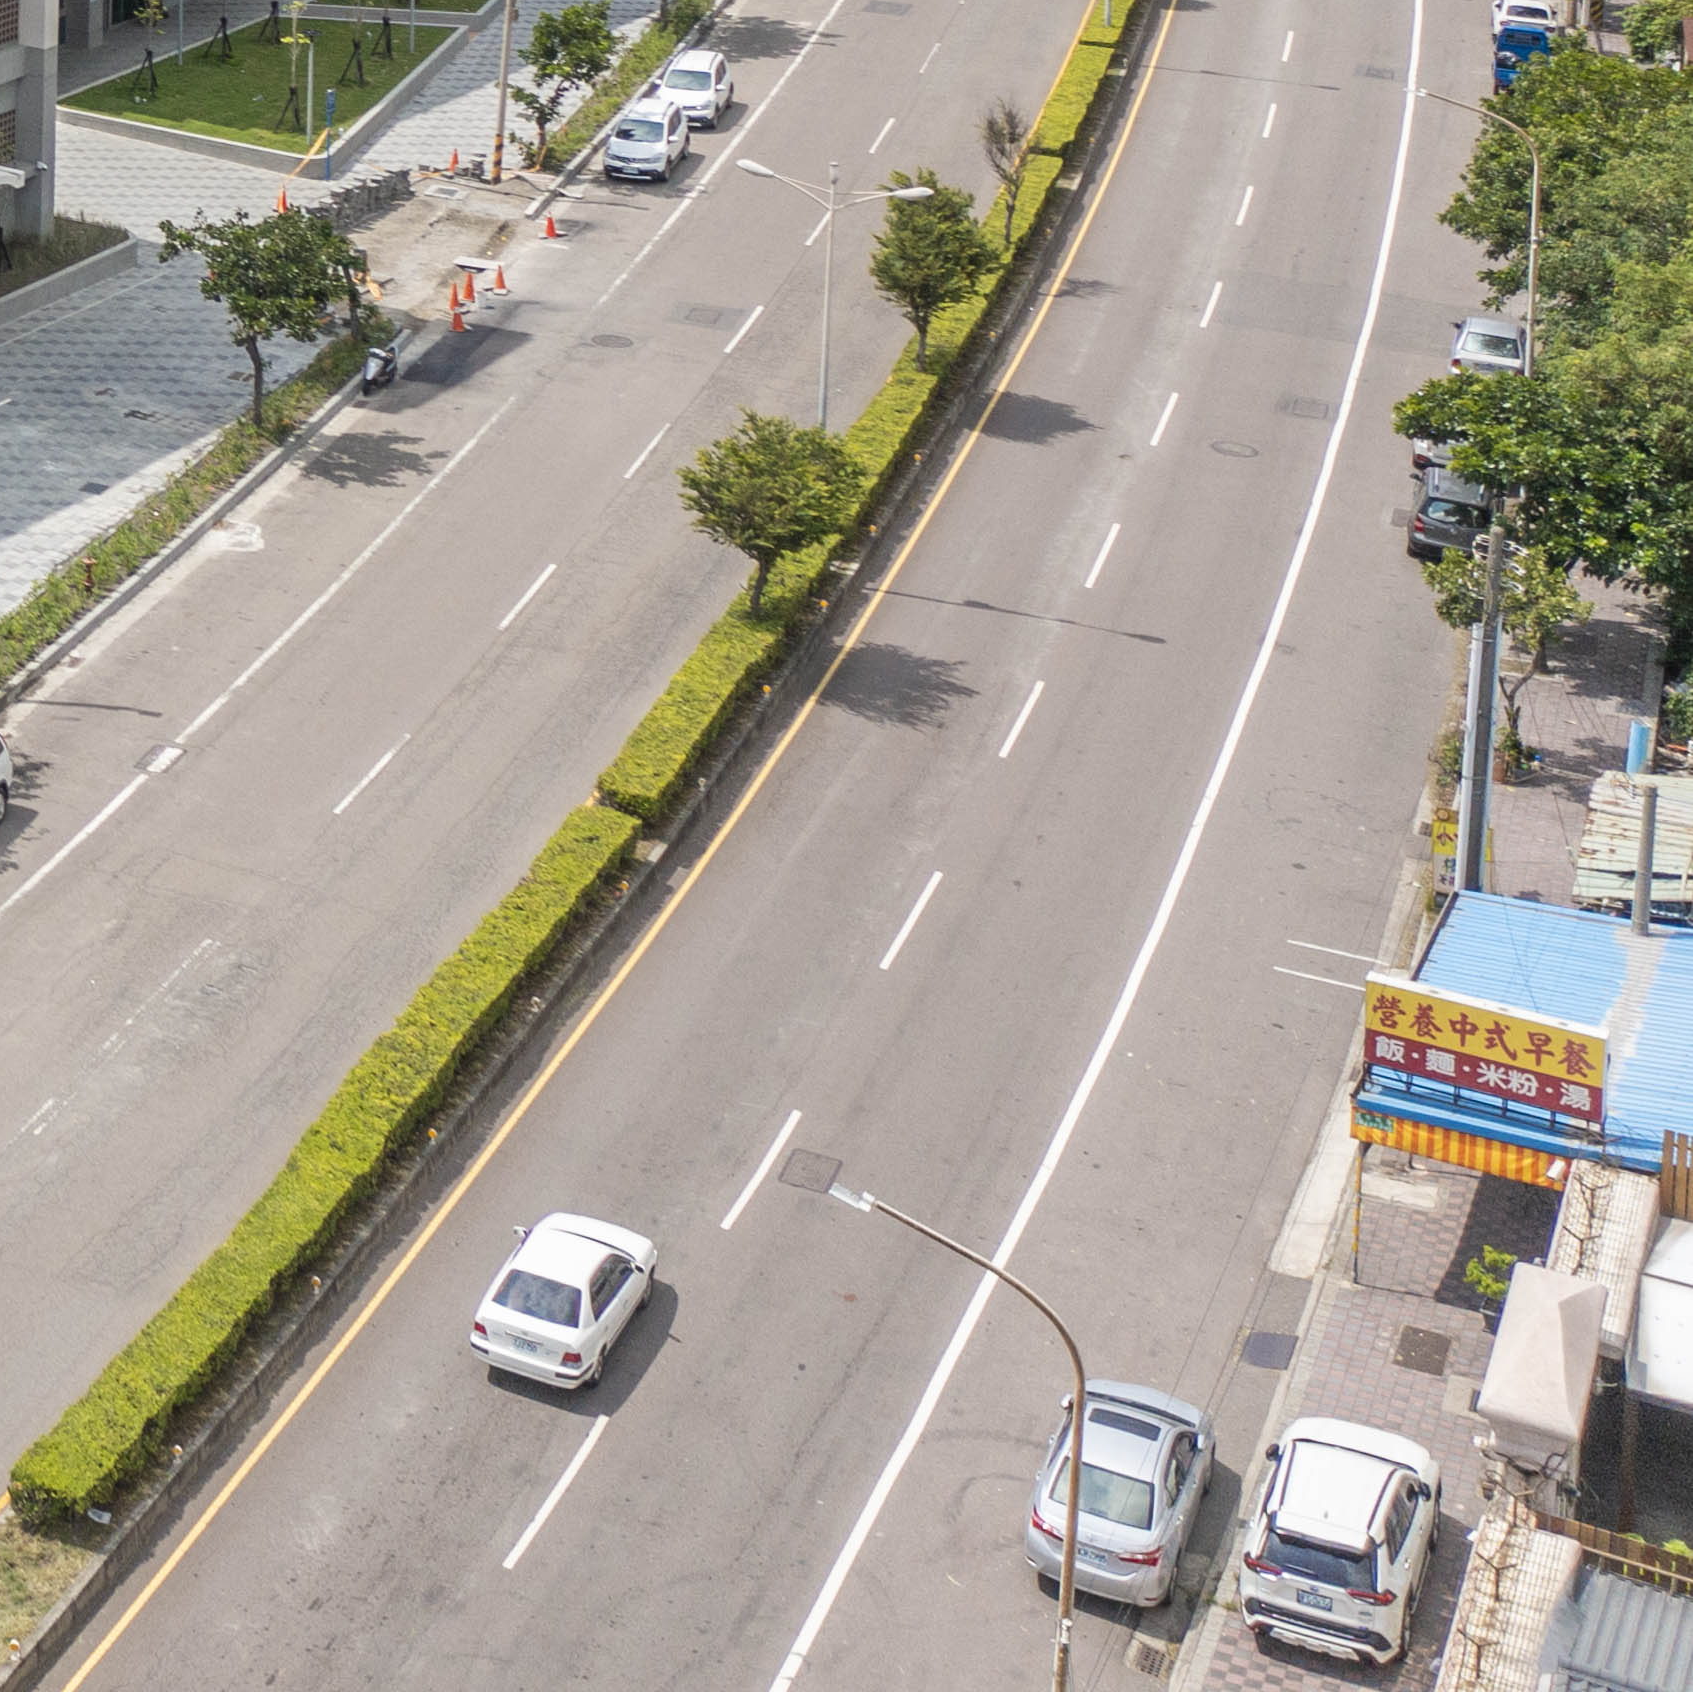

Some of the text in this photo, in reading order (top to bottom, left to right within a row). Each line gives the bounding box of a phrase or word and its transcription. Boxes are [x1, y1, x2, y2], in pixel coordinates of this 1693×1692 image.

[1372, 994, 1597, 1078] 營養中式早餐
